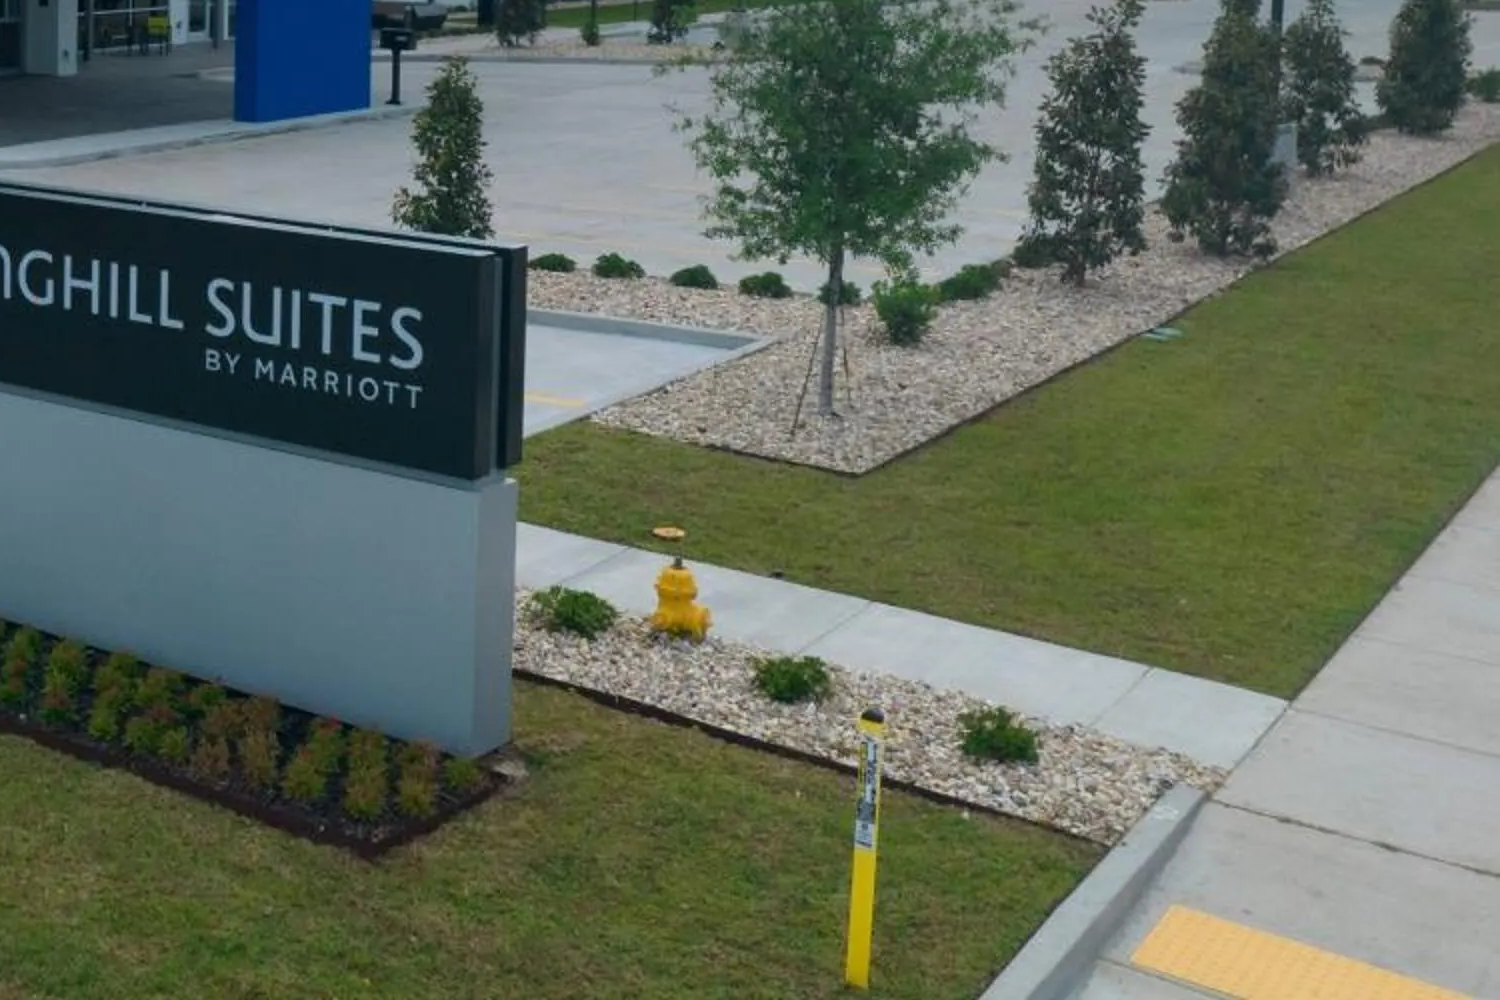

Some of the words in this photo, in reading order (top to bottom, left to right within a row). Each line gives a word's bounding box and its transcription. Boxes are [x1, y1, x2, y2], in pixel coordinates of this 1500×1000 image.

[205, 278, 423, 370] SUITES
[205, 349, 241, 374] BY
[255, 357, 422, 408] MARRIOTT
